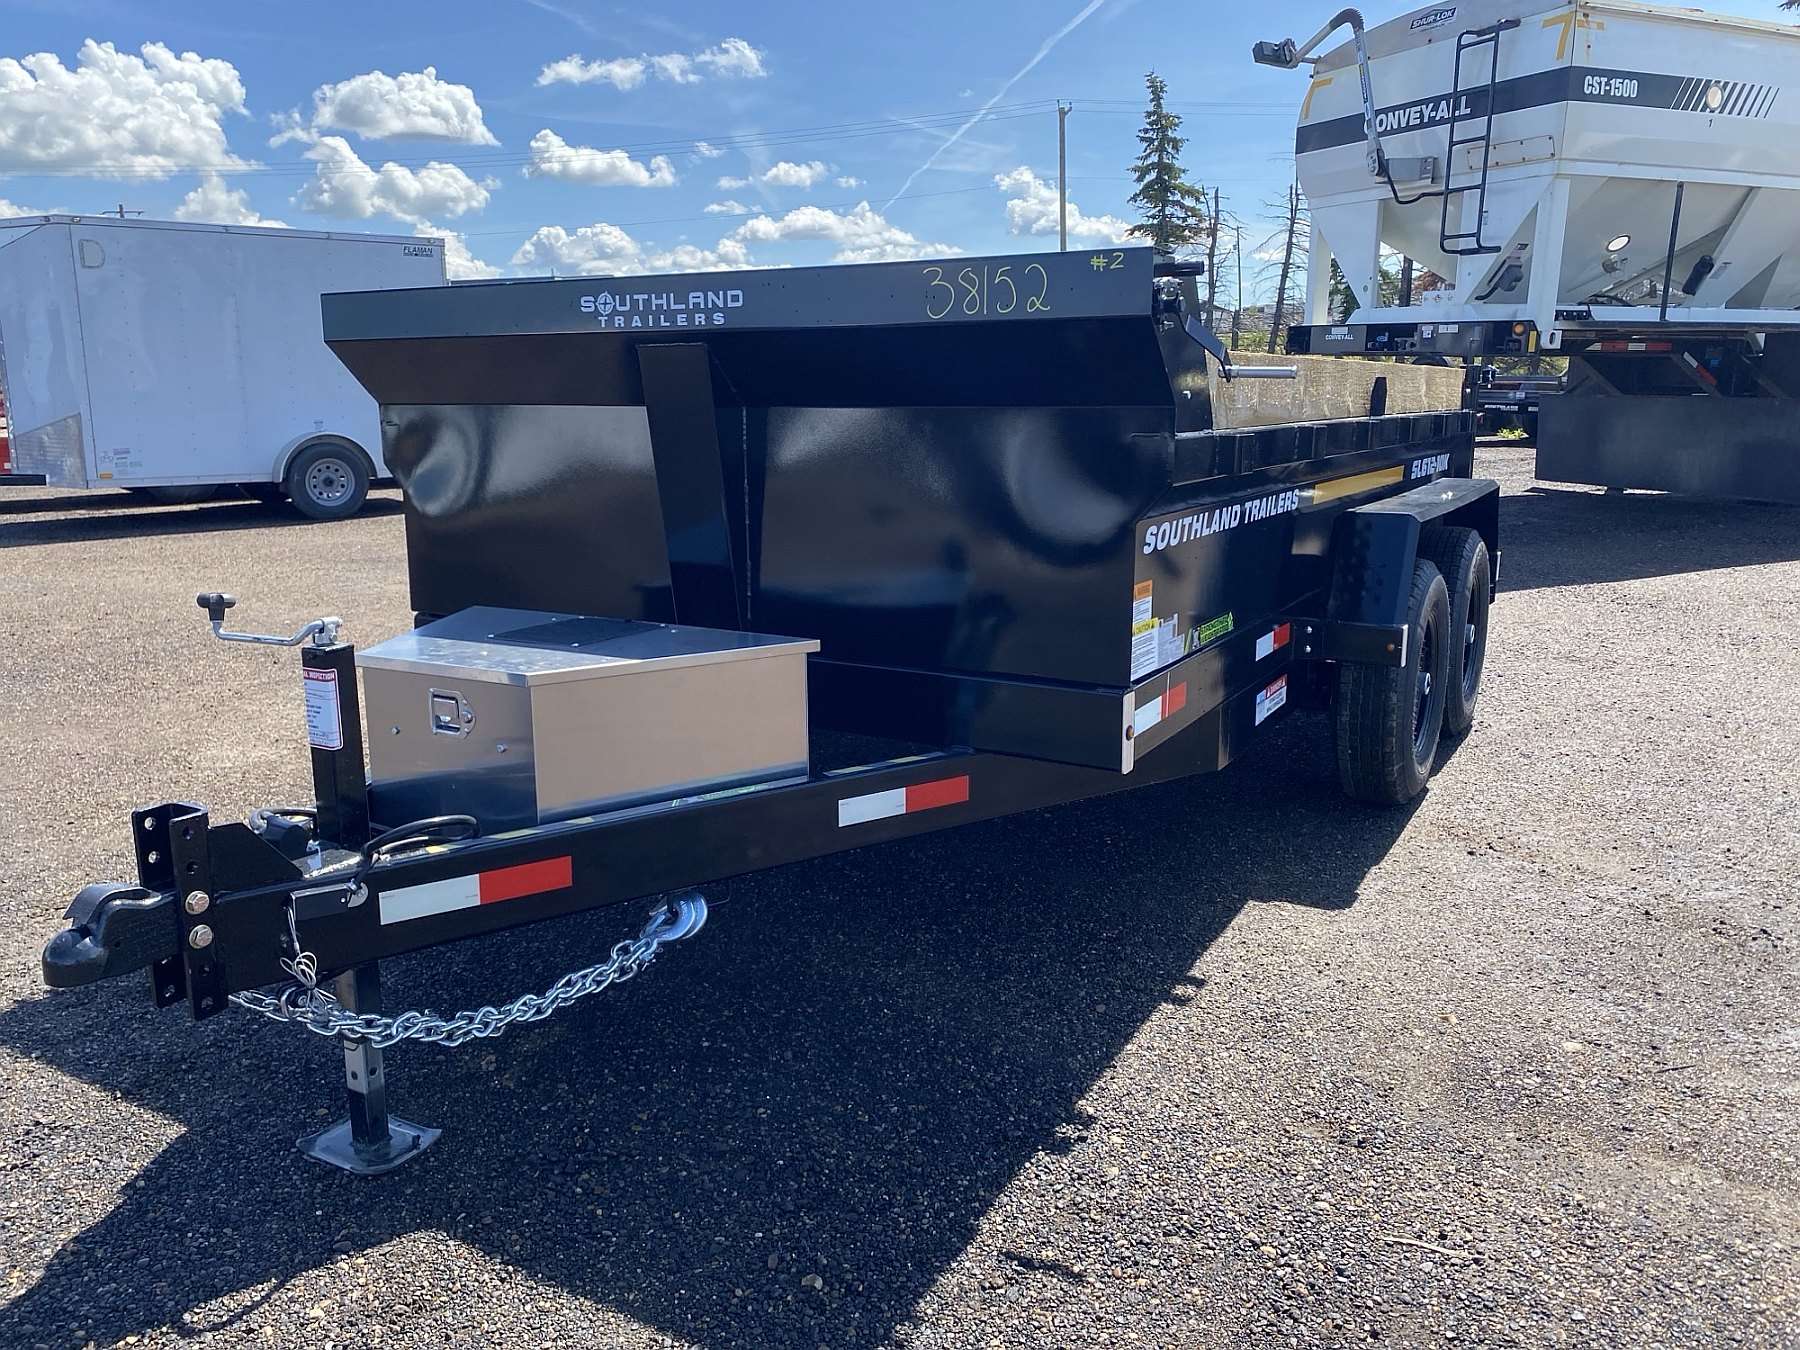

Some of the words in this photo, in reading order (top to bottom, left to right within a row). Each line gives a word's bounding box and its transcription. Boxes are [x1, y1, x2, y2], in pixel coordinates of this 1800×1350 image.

[1584, 75, 1638, 98] CST-1500
[922, 263, 1051, 319] 38152
[1090, 251, 1125, 272] #2
[580, 289, 744, 316] SOUTHLAND
[598, 312, 726, 328] TRAILERS
[1143, 504, 1241, 555] SOUTHLAND
[1244, 488, 1300, 524] TRAILERS
